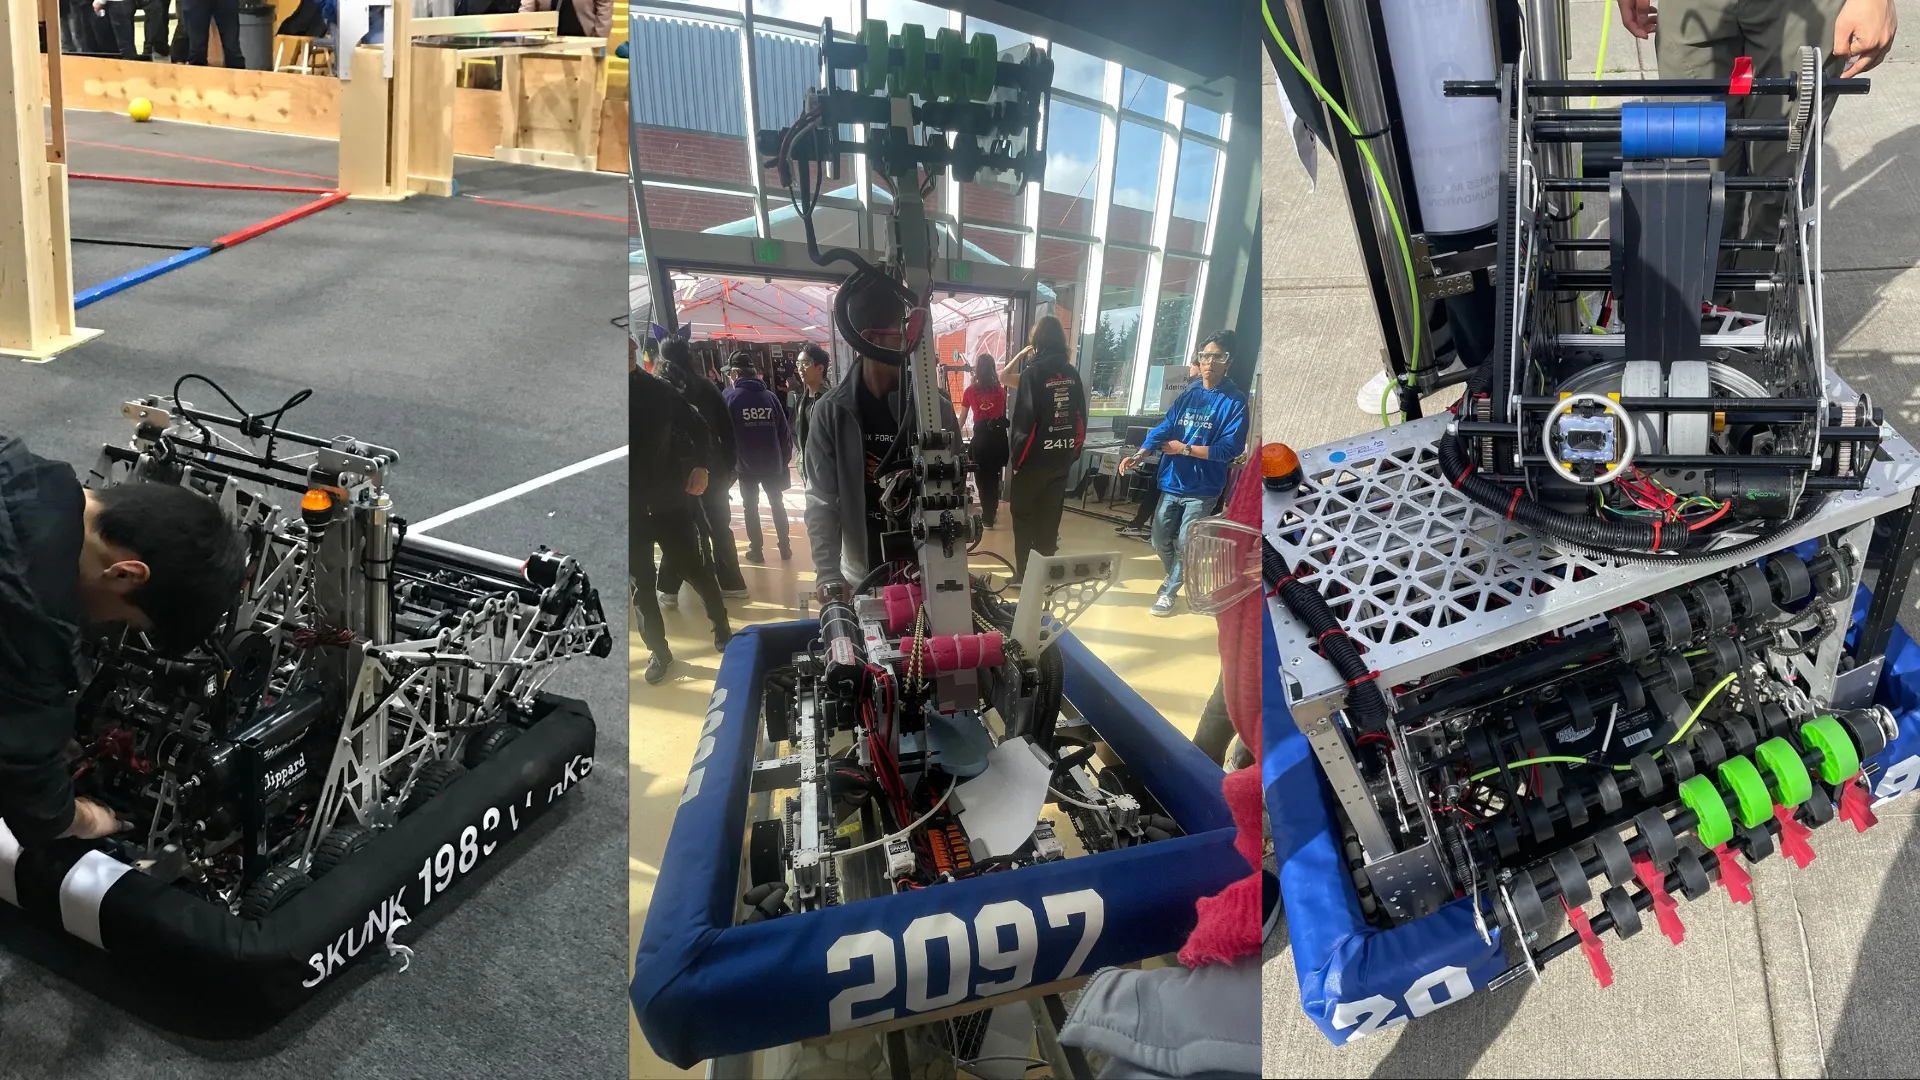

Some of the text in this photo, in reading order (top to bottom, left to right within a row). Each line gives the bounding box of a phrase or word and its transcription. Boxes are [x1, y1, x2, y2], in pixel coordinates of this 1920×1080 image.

[742, 407, 773, 421] 5827
[1043, 438, 1075, 450] 2412
[264, 751, 306, 791] lippard
[302, 885, 412, 988] SKUNK
[826, 888, 1105, 1033] 2097
[1331, 965, 1475, 1043] 20
